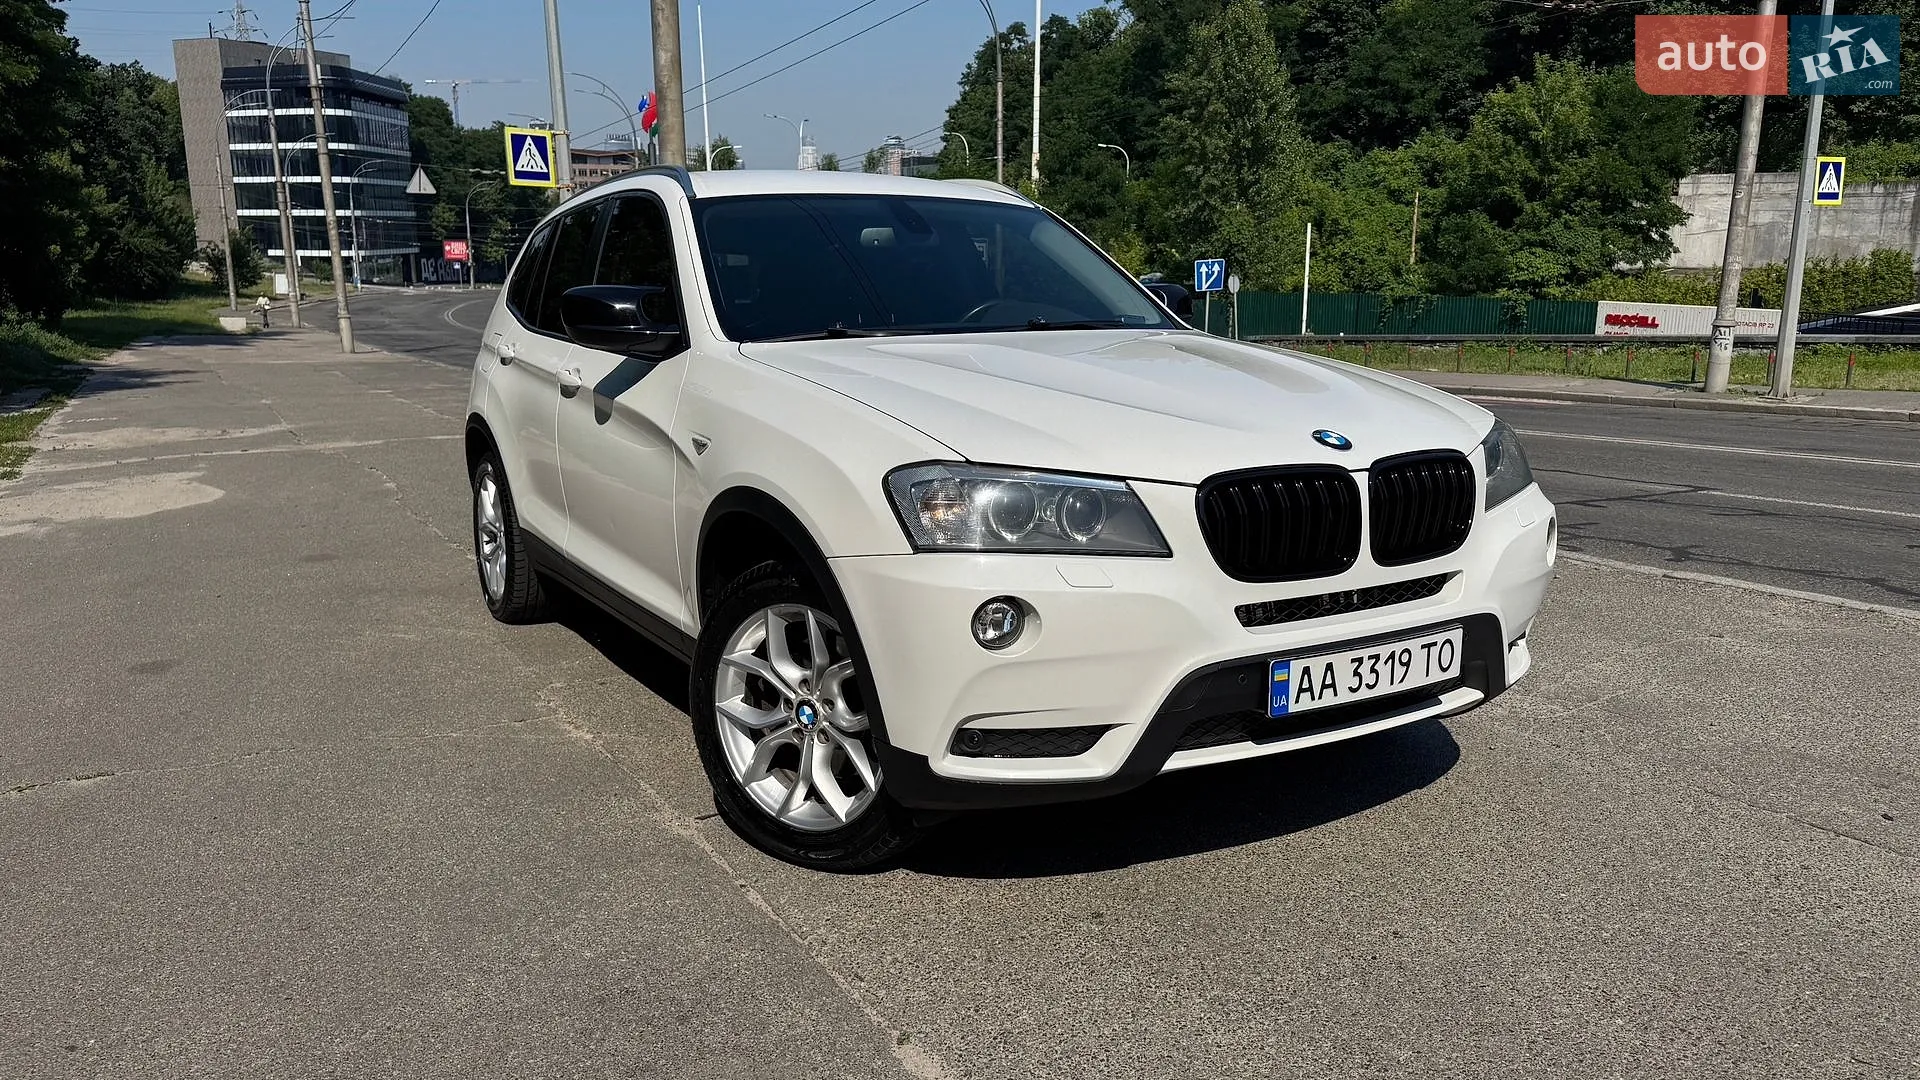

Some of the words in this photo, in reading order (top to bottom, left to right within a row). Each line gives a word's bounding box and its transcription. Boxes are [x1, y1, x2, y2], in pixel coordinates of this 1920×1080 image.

[1294, 662, 1338, 704] AA
[1347, 647, 1412, 693] 3319
[1420, 638, 1455, 677] TO
[1273, 695, 1287, 707] UA
